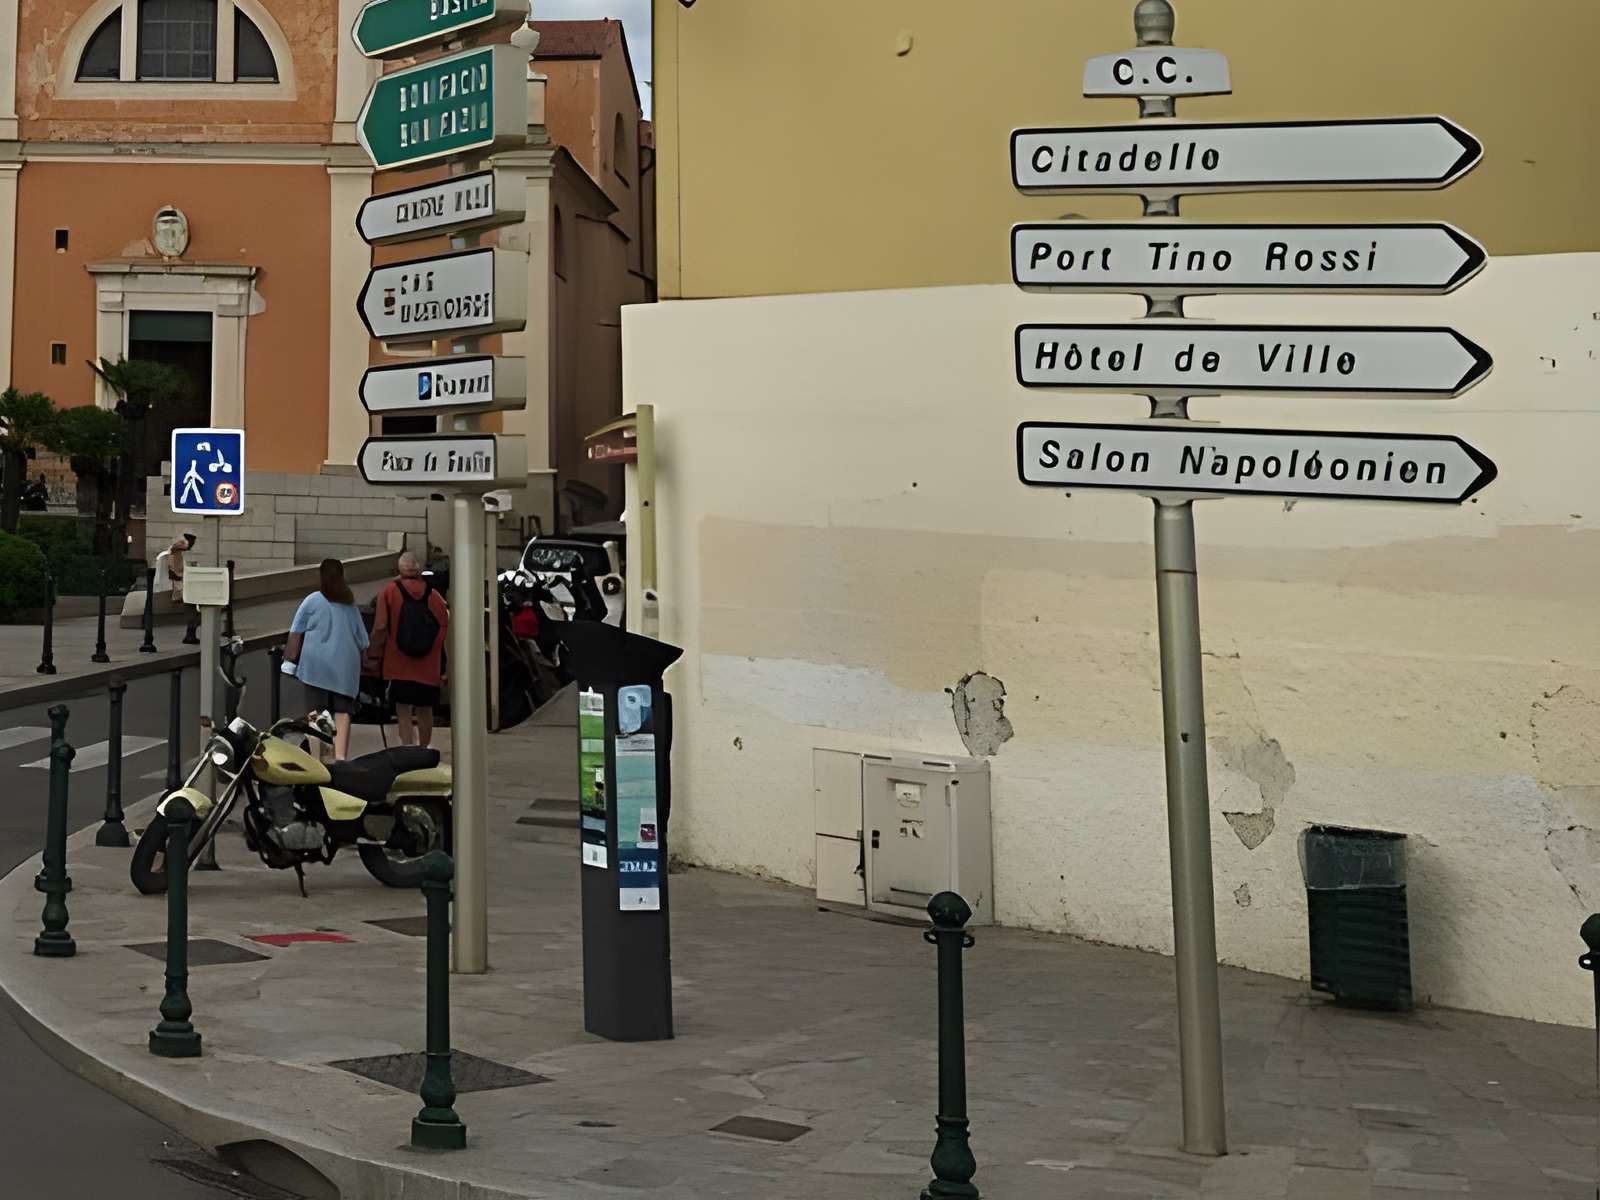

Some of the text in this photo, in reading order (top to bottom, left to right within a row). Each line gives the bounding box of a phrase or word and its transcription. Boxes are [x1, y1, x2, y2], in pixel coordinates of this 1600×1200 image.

[1113, 57, 1192, 85] C.C.
[1032, 143, 1219, 172] Citadelle
[1031, 242, 1376, 271] Port Tino Rossi
[1036, 342, 1355, 375] Hôtel de Ville
[1039, 440, 1447, 485] Salon Napoléonien
